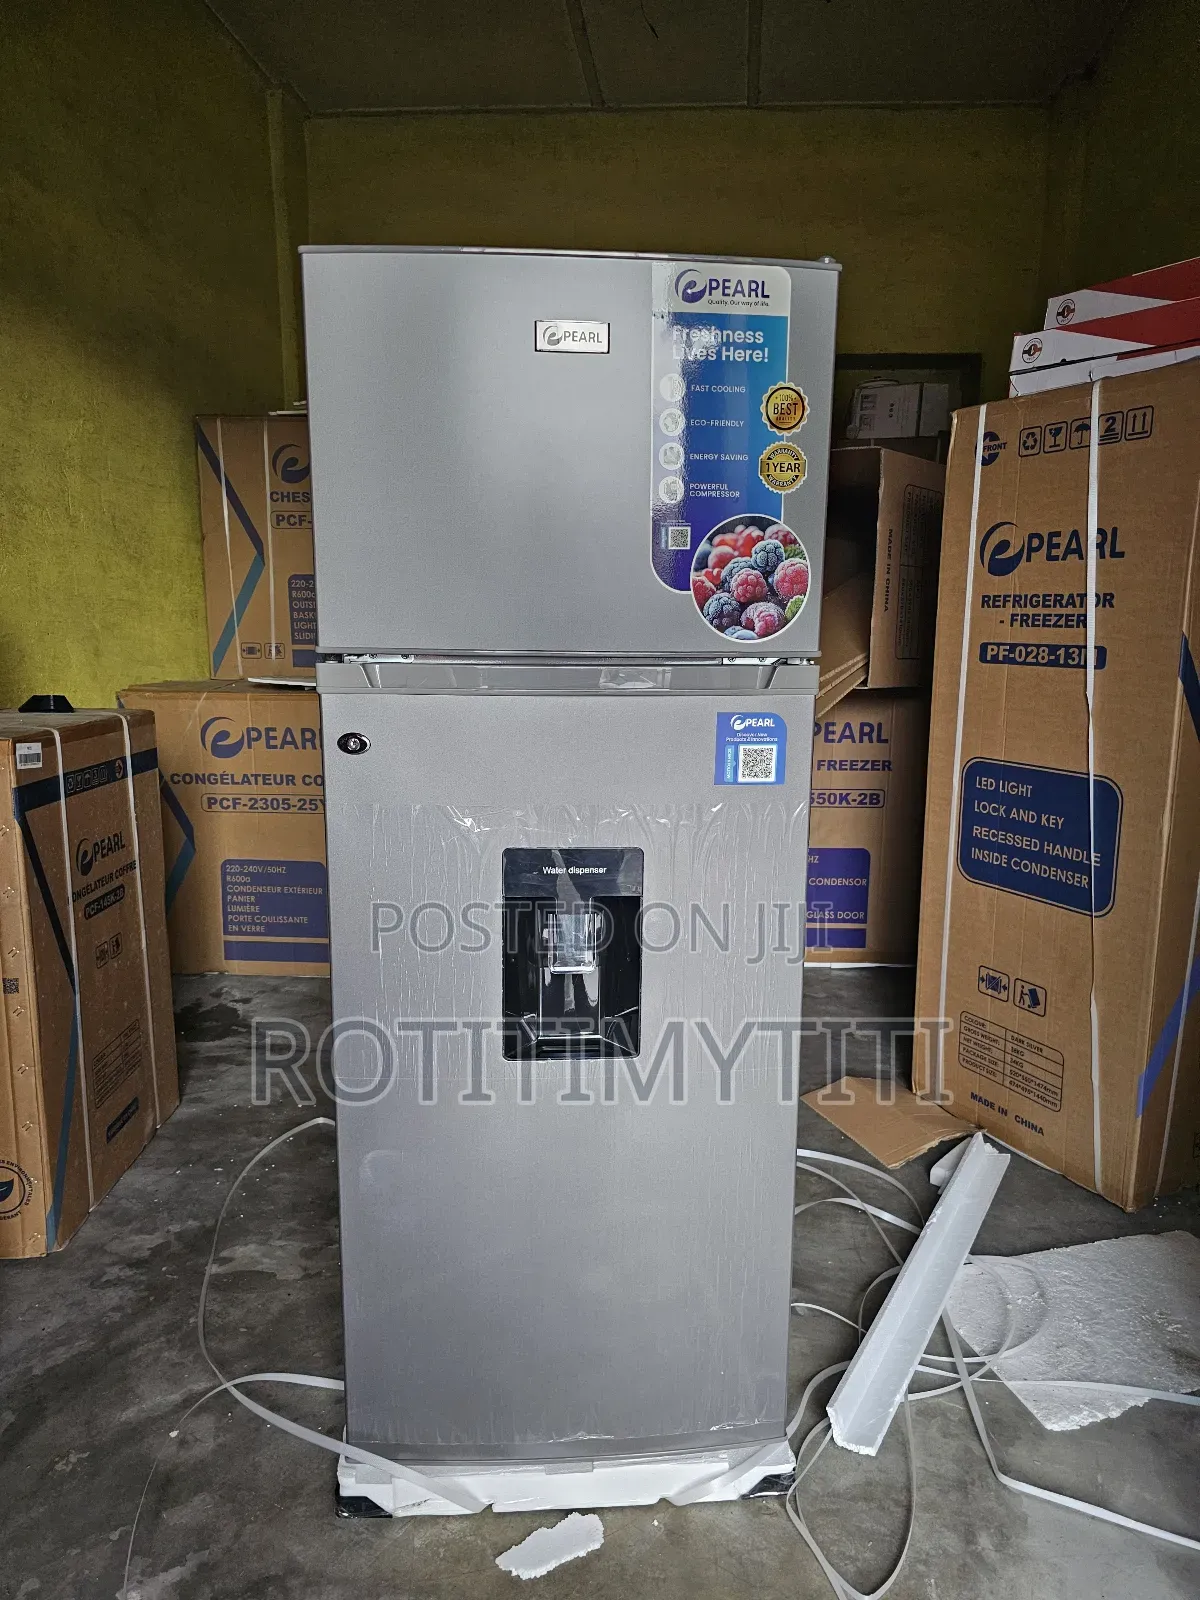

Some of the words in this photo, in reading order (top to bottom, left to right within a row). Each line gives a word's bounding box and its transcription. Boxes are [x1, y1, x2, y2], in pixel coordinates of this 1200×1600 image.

[708, 278, 770, 298] PEARL
[564, 331, 602, 343] PEARL
[672, 326, 764, 343] Freshness
[722, 347, 768, 362] Here!
[774, 403, 798, 415] BEST
[1104, 416, 1116, 433] 2
[983, 442, 1007, 452] FRONT
[766, 463, 770, 472] 1
[772, 463, 800, 472] YEAR
[270, 491, 310, 502] CHES
[276, 514, 312, 526] PCF-
[1026, 527, 1125, 562] PEARL
[886, 563, 891, 575] IN
[1010, 613, 1087, 628] FREEZER
[746, 718, 775, 727] PEARL
[246, 726, 322, 750] PEAR
[817, 760, 892, 771] FREEZER
[170, 771, 296, 786] CONGÉLATEUR
[976, 776, 996, 790] LED
[1000, 780, 1032, 797] LIGHT
[974, 800, 1006, 818] LOCK
[1010, 808, 1037, 824] AND
[1041, 814, 1064, 830] KEY
[93, 831, 125, 862] PEARL
[973, 825, 1040, 851] RECESSED
[1044, 841, 1100, 866] HANDLE
[226, 865, 286, 873] 220-240V/50HZ
[543, 866, 566, 874] Water
[568, 867, 607, 875] dispenser
[972, 847, 1008, 867] INSIDE
[1011, 857, 1088, 889] CONDENSER
[68, 873, 114, 905] ONGÉLATEUR
[115, 860, 136, 879] COFFRE
[809, 878, 867, 886] CONDENSOR
[227, 885, 281, 893] CONDENSEUR
[284, 886, 322, 894] EXTÉRIEUR
[228, 904, 260, 912] LUMIÈRE
[806, 911, 834, 919] GLASS
[964, 1026, 979, 1037] GROSS
[1011, 1035, 1025, 1046] DARK
[1026, 1042, 1044, 1054] SILVER
[963, 1047, 987, 1061] PACKAGE
[963, 1058, 985, 1071] PRODUCT
[970, 1091, 995, 1112] MADE
[998, 1104, 1008, 1117] IN
[1014, 1114, 1044, 1136] CHINA
